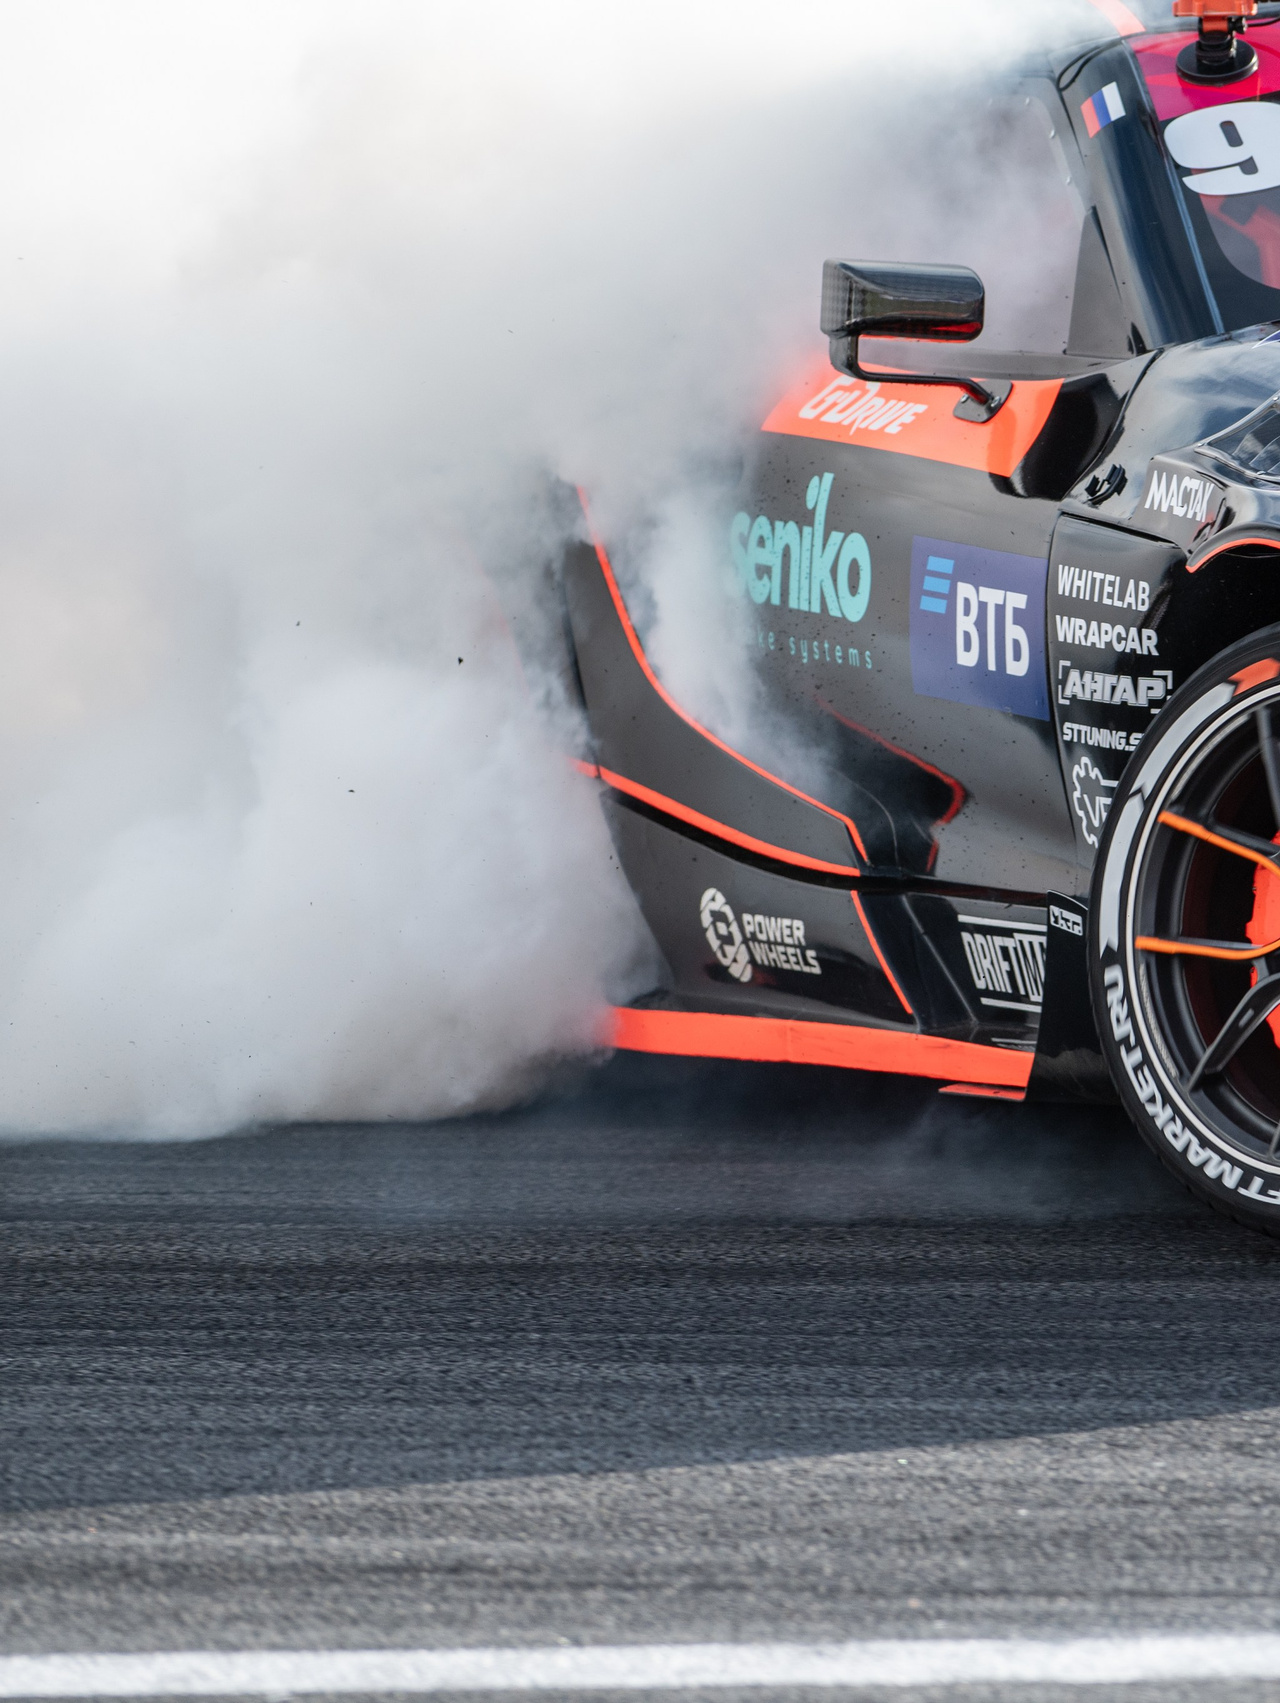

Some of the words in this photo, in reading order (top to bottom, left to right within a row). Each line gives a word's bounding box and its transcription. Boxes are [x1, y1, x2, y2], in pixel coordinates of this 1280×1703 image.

[730, 472, 872, 623] seniko
[1057, 564, 1150, 611] WHITELAB
[955, 581, 1030, 677] ВТБ
[1055, 615, 1159, 656] WRAPCAR
[788, 636, 873, 669] systems
[742, 913, 806, 946] POWER
[748, 940, 822, 975] WHEELS
